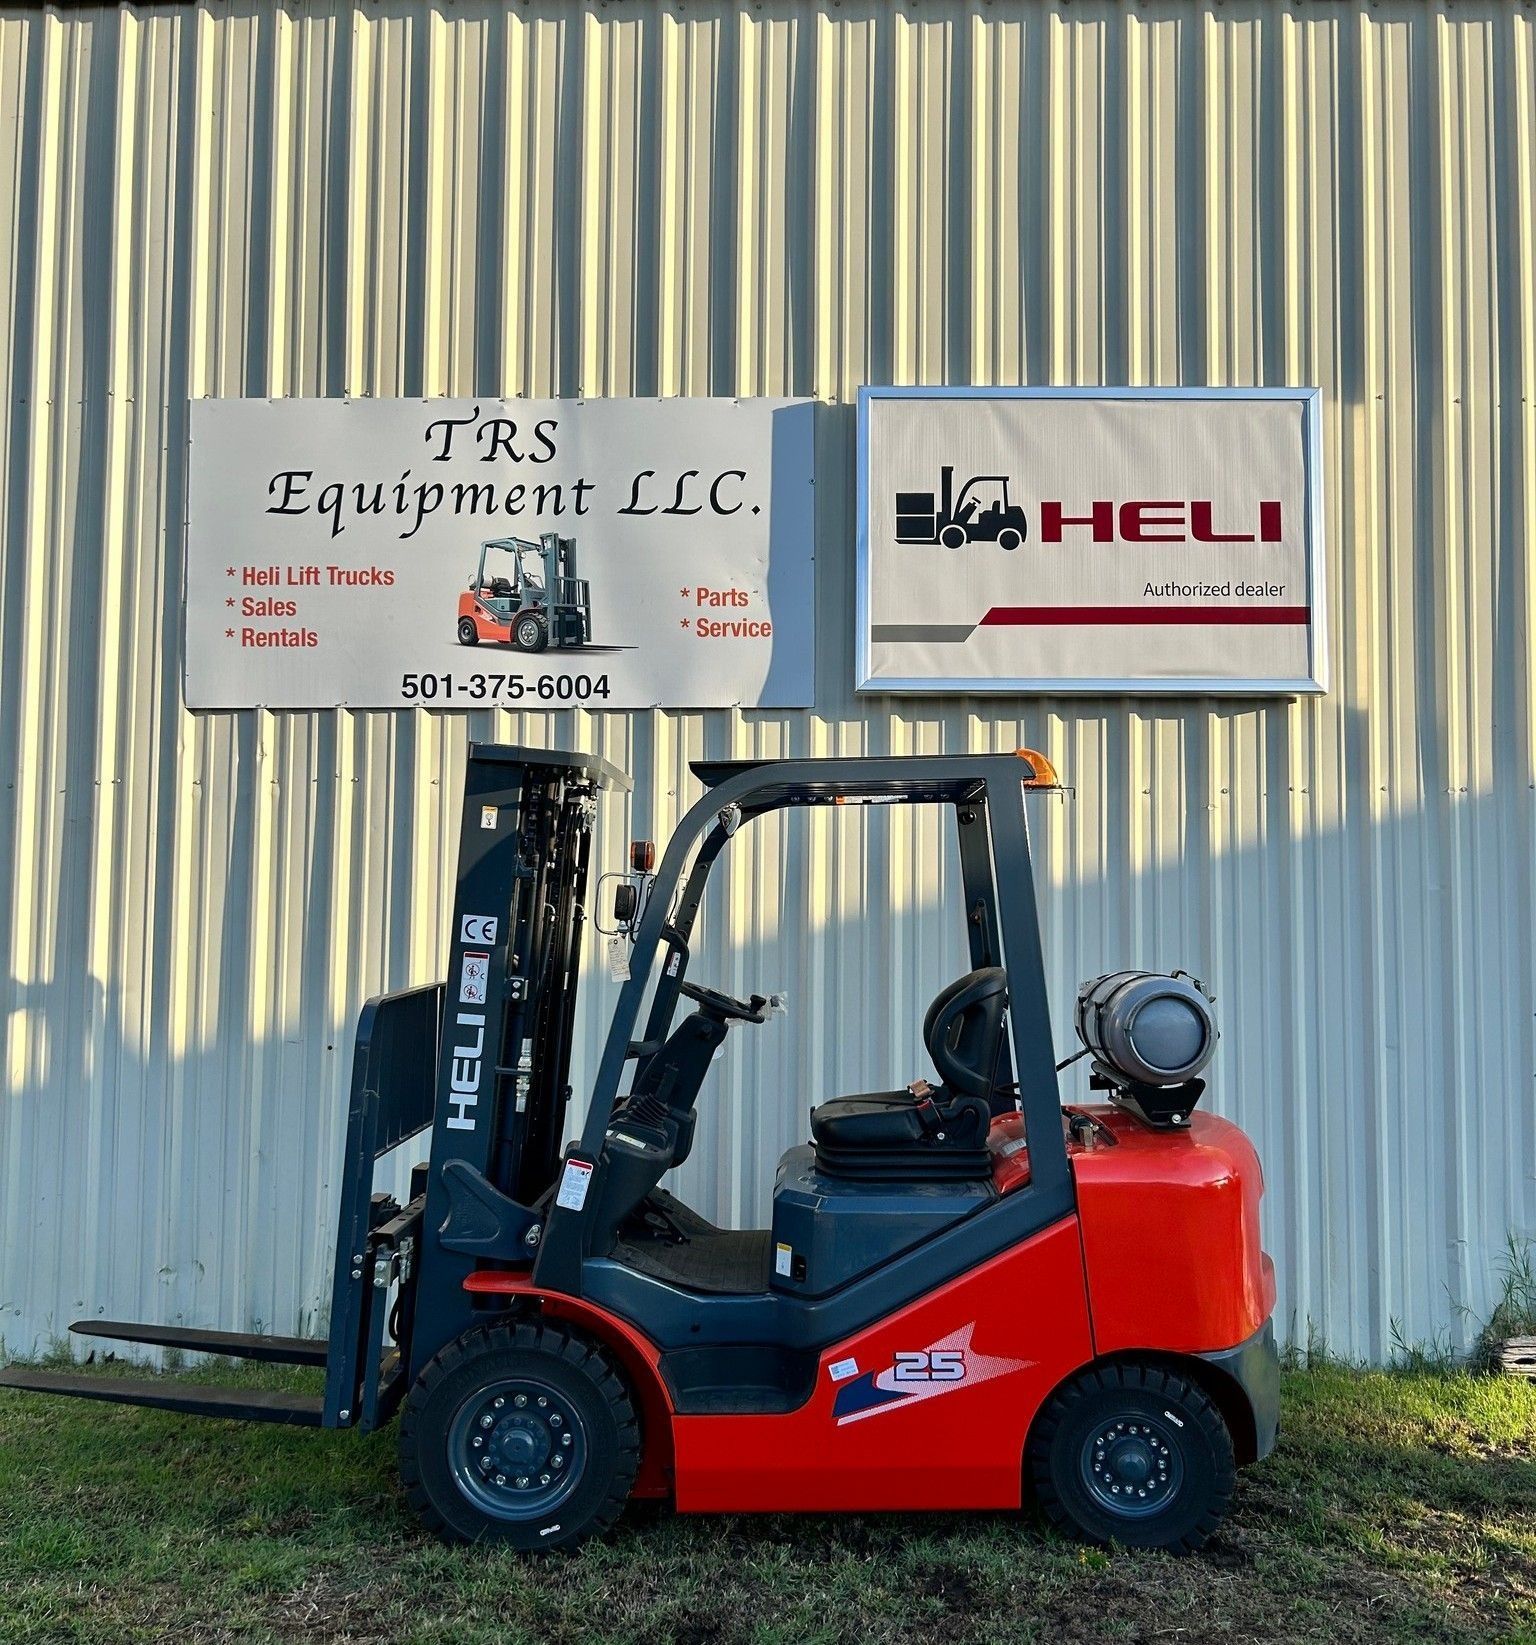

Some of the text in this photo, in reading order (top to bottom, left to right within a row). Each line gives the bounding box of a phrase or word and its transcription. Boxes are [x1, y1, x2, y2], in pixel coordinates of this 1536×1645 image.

[424, 404, 559, 463] TRS
[265, 469, 761, 539] Equipment LLC.
[1040, 501, 1282, 543] HELI
[241, 566, 396, 587] Heli Lift Trucks
[1143, 580, 1286, 598] Authorized dealer
[240, 596, 297, 618] Sales
[695, 586, 750, 608] Parts
[240, 626, 319, 648] Rentals
[695, 617, 772, 640] Service
[401, 673, 611, 701] 501-375-6004
[446, 1012, 486, 1131] HELI
[893, 1350, 966, 1382] 25
